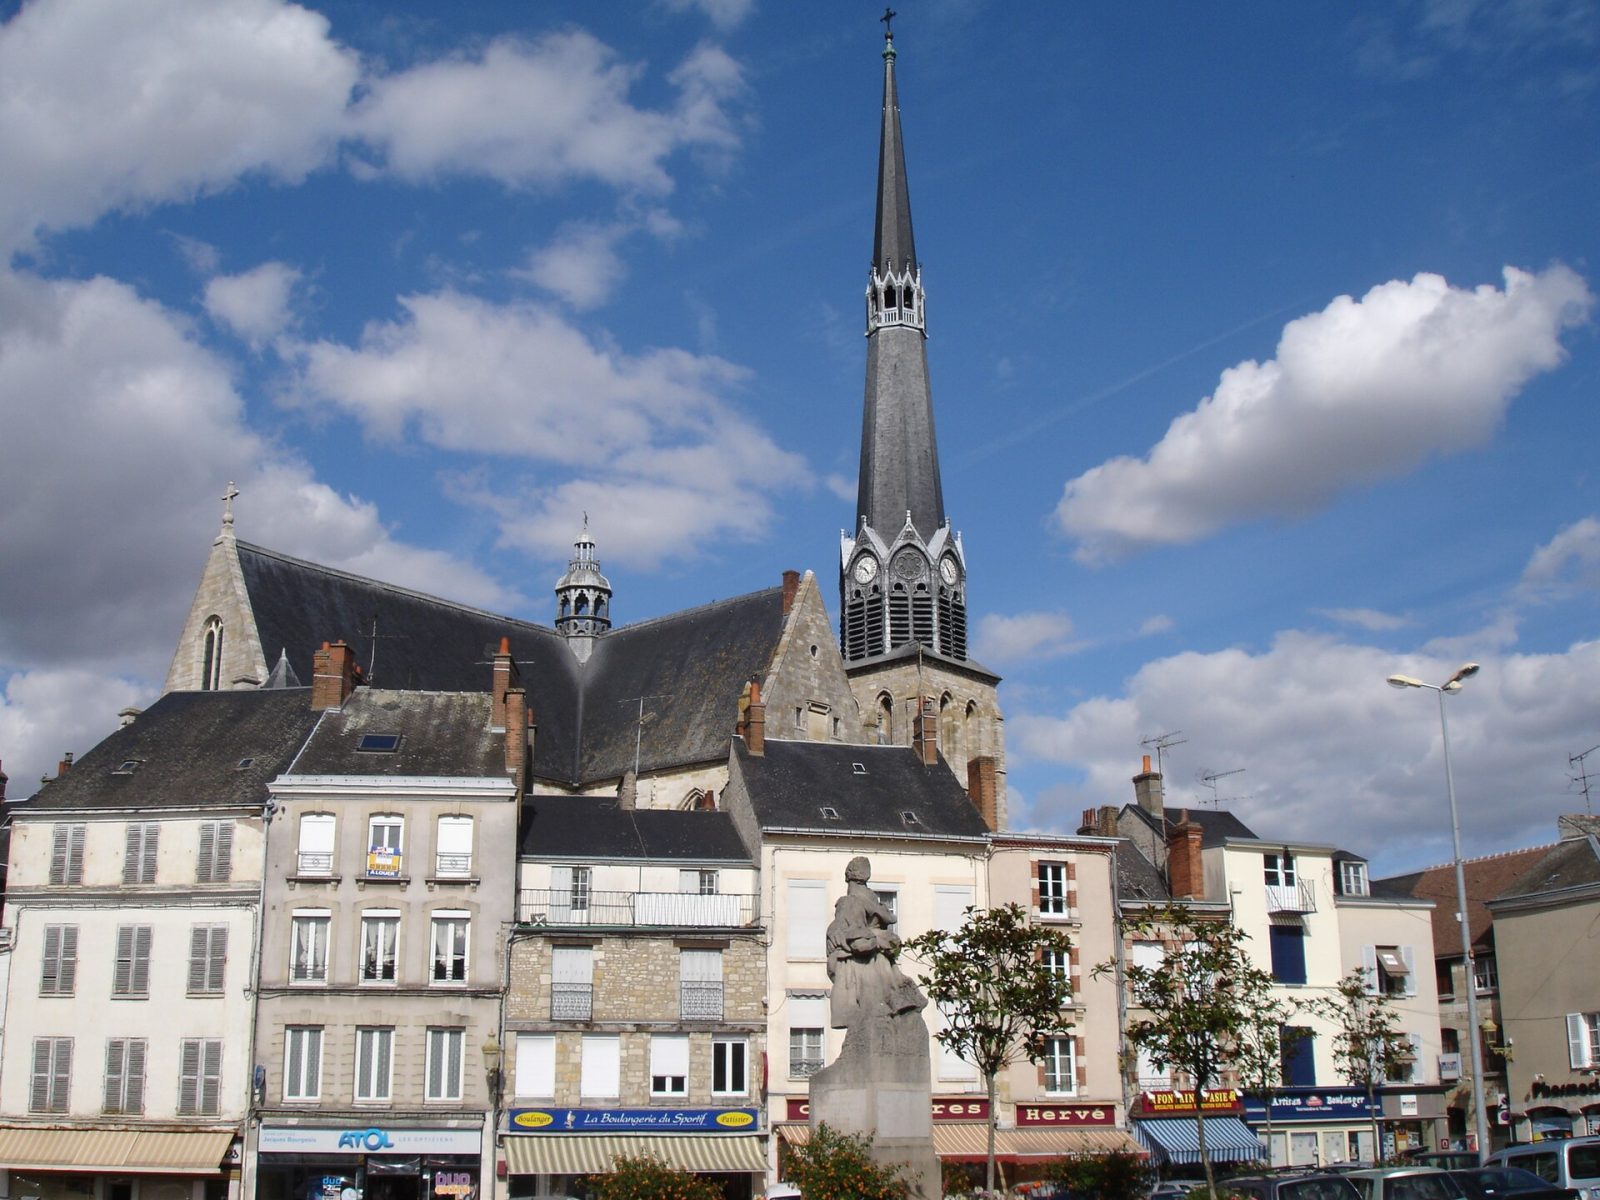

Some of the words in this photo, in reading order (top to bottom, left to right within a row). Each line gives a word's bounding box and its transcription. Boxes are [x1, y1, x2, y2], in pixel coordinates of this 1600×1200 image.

[1271, 1096, 1302, 1107] Artisan
[1326, 1094, 1365, 1108] Boulanger
[518, 1114, 551, 1125] Boulanger
[583, 1113, 598, 1123] La
[600, 1112, 656, 1126] Boulangerie
[659, 1113, 671, 1123] du
[672, 1112, 708, 1126] Sportif
[1026, 1107, 1106, 1120] Hervé
[262, 1135, 286, 1143] Jacques
[338, 1128, 394, 1151] ATOL
[322, 1175, 341, 1185] duo
[435, 1172, 471, 1186] DUO
